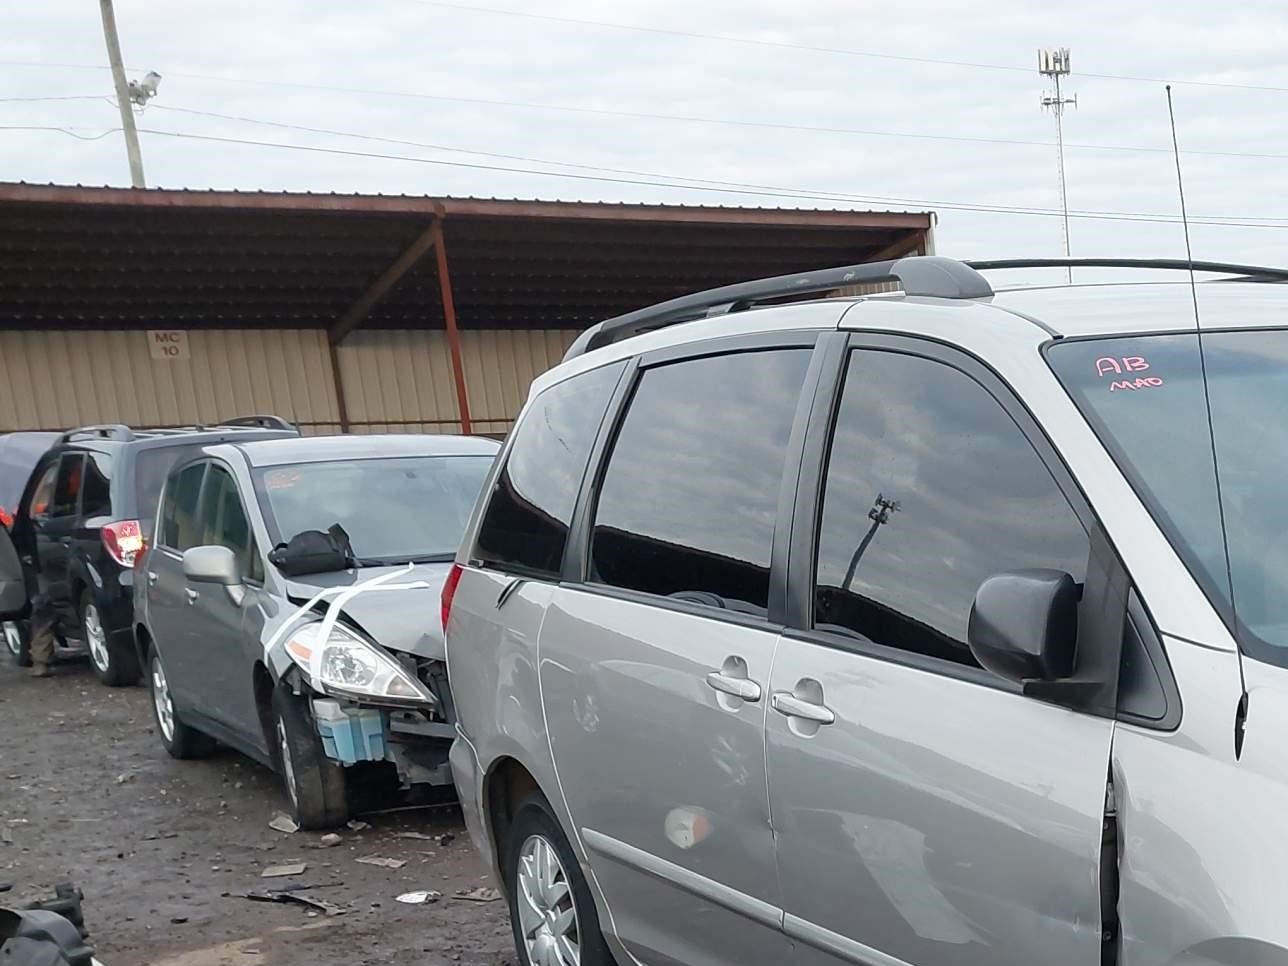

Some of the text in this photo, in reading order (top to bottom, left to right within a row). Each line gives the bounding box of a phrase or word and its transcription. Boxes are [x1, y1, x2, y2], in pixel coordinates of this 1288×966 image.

[155, 332, 180, 343] MC
[162, 345, 180, 356] 10
[1096, 356, 1150, 377] AB
